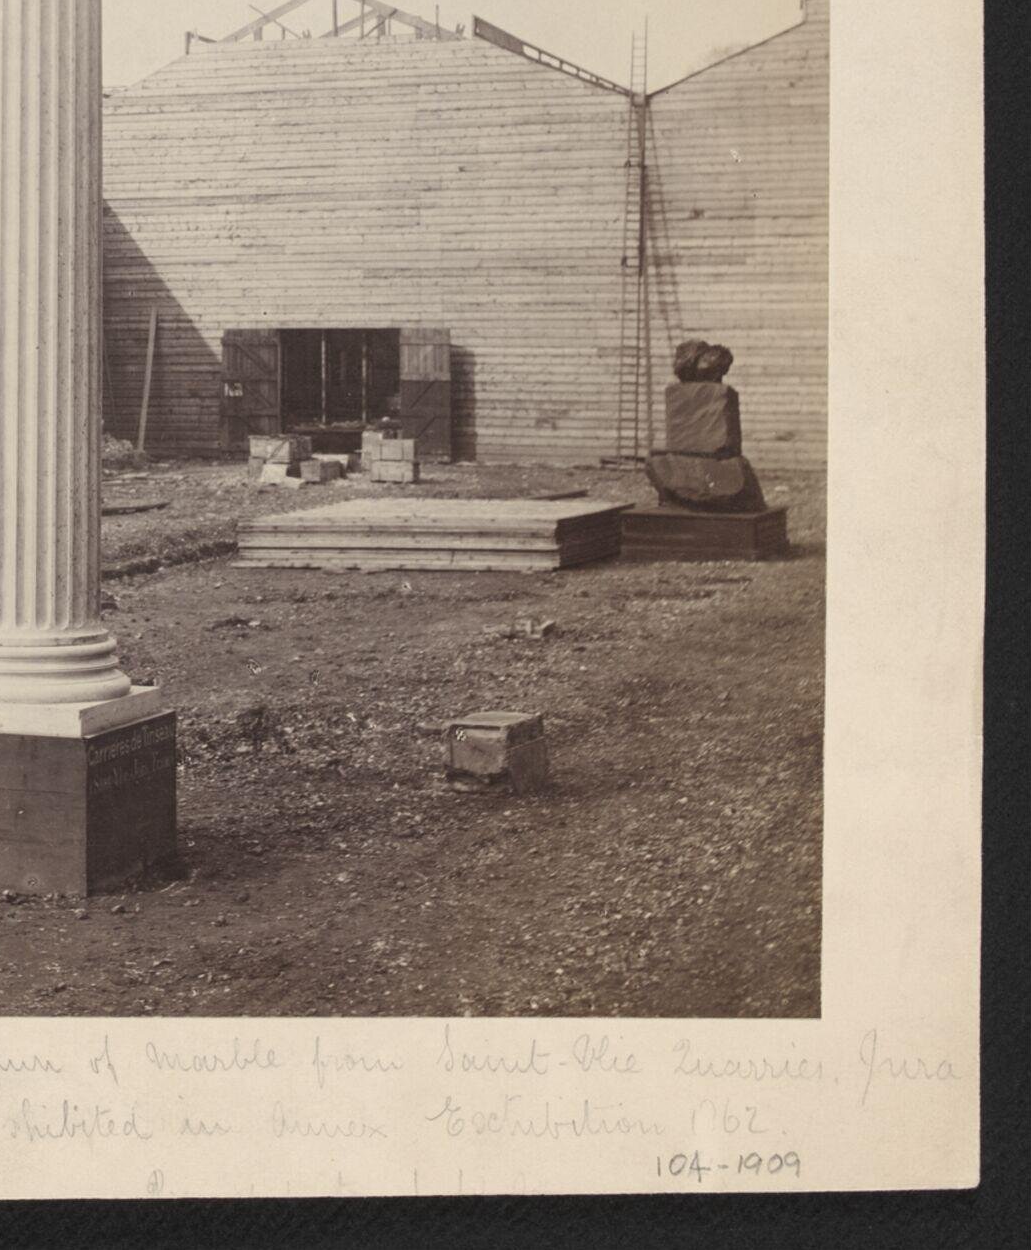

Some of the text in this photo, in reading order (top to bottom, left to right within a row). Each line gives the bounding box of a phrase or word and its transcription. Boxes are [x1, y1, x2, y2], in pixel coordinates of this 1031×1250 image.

[89, 1034, 119, 1086] of
[312, 1036, 404, 1089] from
[859, 1028, 962, 1106] Jura
[177, 1095, 232, 1137] in
[657, 1149, 801, 1183] 104-1909
